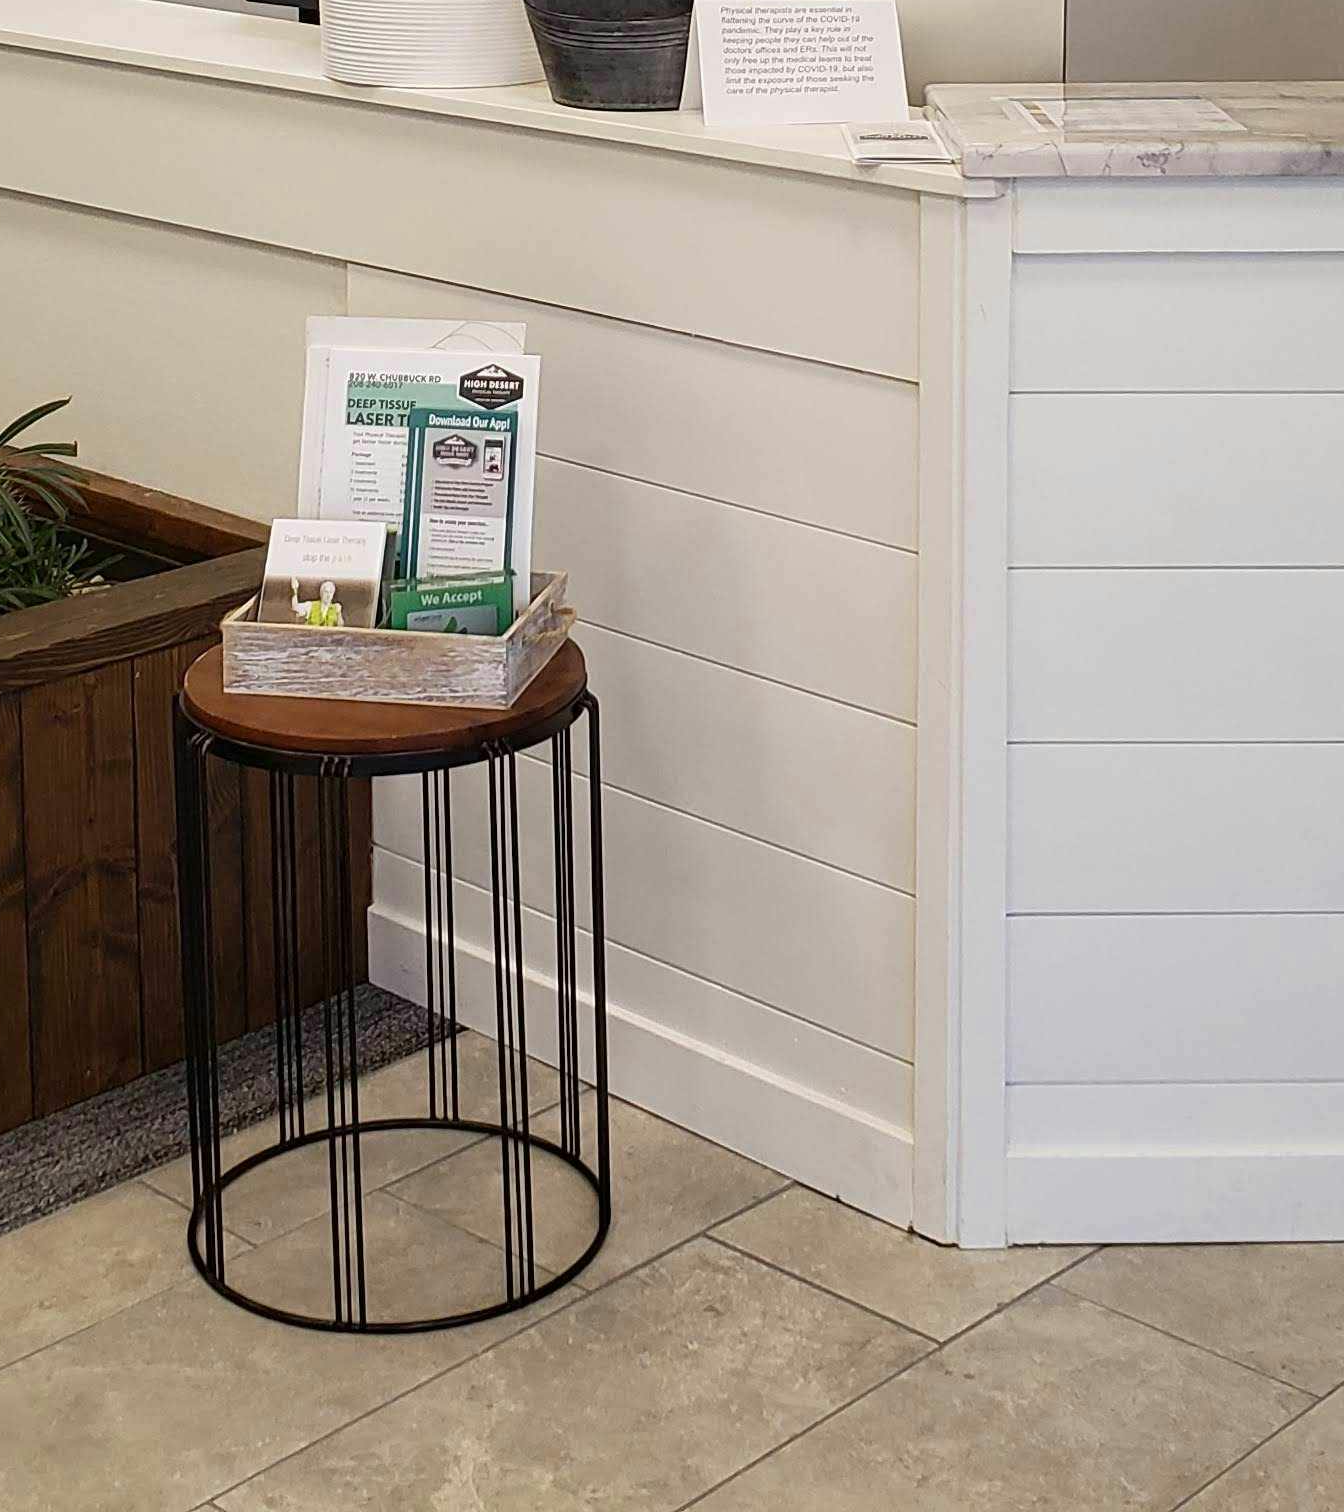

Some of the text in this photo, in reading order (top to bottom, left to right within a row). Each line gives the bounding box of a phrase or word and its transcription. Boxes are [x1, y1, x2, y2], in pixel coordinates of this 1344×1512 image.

[347, 398, 376, 409] DEEP
[346, 411, 394, 426] LASER
[428, 413, 511, 431] Download Our App!
[420, 589, 483, 607] We Accept
